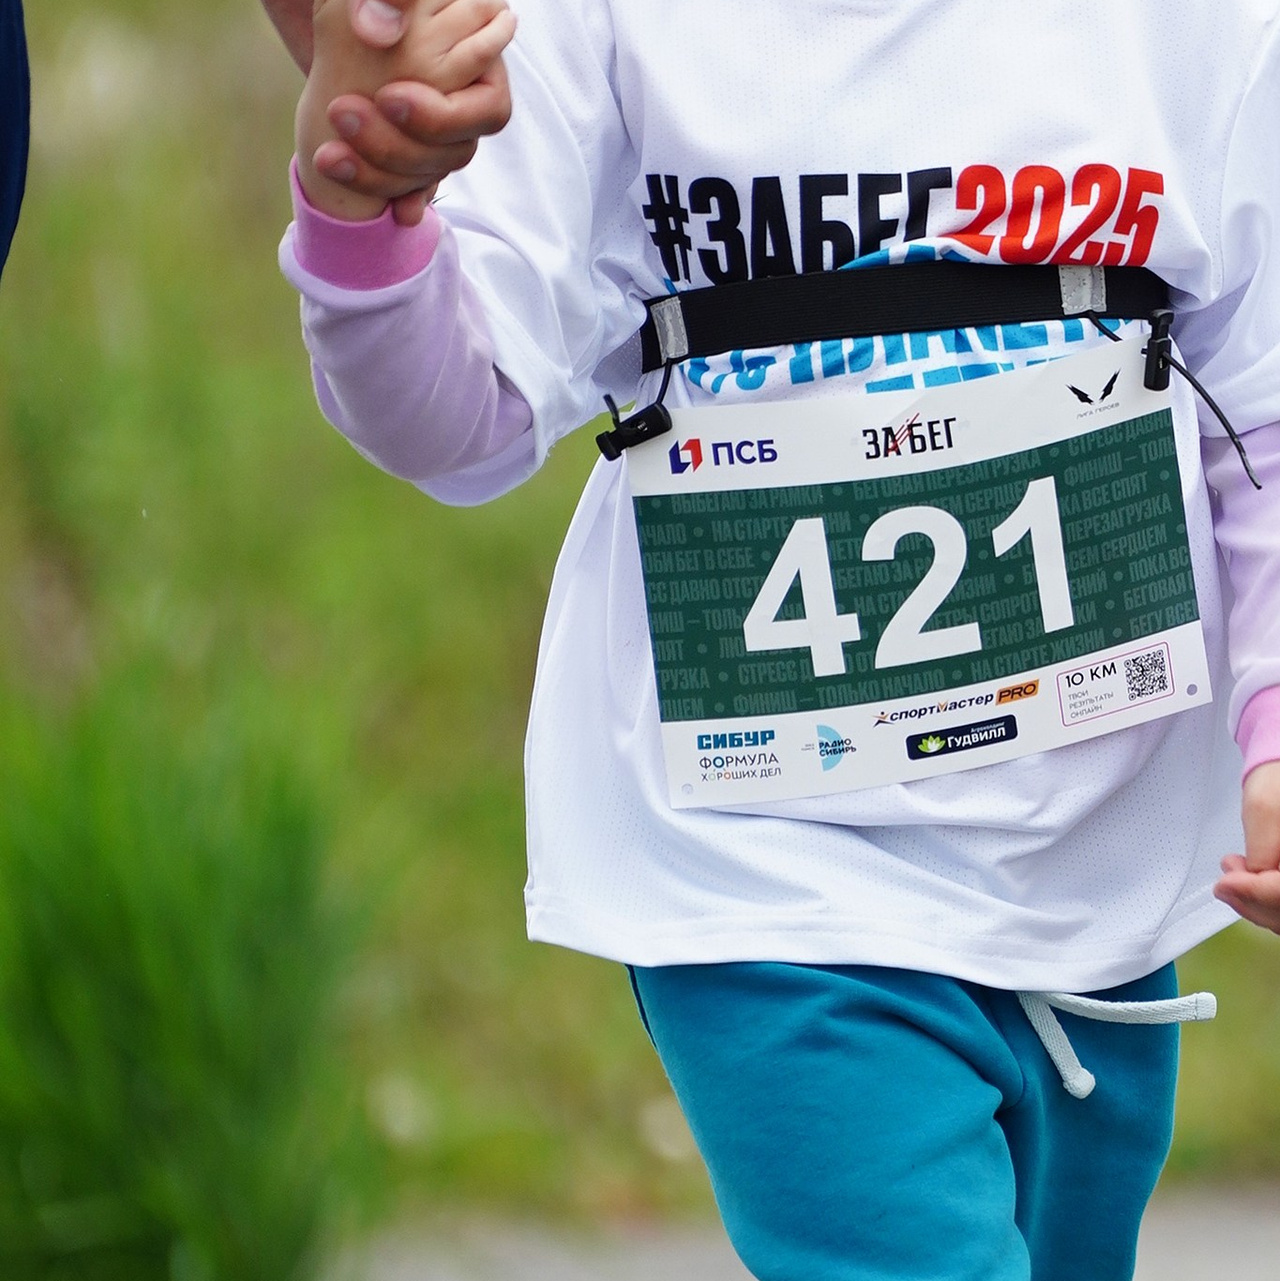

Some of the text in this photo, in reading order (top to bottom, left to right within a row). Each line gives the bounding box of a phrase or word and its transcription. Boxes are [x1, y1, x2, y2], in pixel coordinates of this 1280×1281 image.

[711, 439, 778, 466] ПСБ
[671, 491, 747, 514] ВЫБЕГАЮ
[749, 490, 770, 509] ЗА
[769, 486, 824, 509] РАМКИ
[926, 450, 1042, 491] ПЕРЕЗАГРУЗКА
[711, 520, 733, 542] НА
[965, 479, 1028, 514] СЕРДЦЕ
[1063, 451, 1123, 487] ФИНИШ
[675, 549, 701, 572] БЕГ
[703, 549, 715, 570] В
[716, 547, 755, 569] СЕБЕ
[1082, 483, 1111, 511] ВСЕ
[1110, 471, 1148, 501] СПЯТ
[669, 578, 721, 605] ДАВНО
[722, 575, 766, 600] ОТСТ
[832, 565, 889, 590] БЕГАЮ
[891, 560, 914, 582] ЗА
[1065, 493, 1172, 544] ПЕРЕЗАГРУЗКА
[702, 607, 750, 631] ТОЛЬ
[945, 573, 997, 604] ИЗНИ
[1066, 545, 1100, 572] СЕМ
[1101, 523, 1168, 562] СЕРДЦЕМ
[742, 476, 1076, 678] 421
[1128, 552, 1168, 582] ПОКА
[738, 660, 798, 685] СТРЕСС
[1123, 574, 1188, 611] БЕГОВАЯ
[733, 690, 797, 715] ФИНИШ
[816, 680, 880, 708] ТОЛЬКО
[881, 668, 945, 698] НАЧАЛО
[970, 659, 993, 682] НА
[993, 644, 1050, 675] СТАРТЕ
[1050, 628, 1105, 661] ЖИЗНИ
[1129, 609, 1163, 638] БЕГУ
[998, 683, 1036, 703] PRO
[1066, 672, 1084, 688] 10
[697, 730, 775, 750] СИБУР
[819, 738, 852, 750] РАДИО
[819, 746, 857, 757] СИБИРЬ
[699, 752, 779, 770] ФОРМУЛА
[701, 767, 781, 782] ХОРОШИХ ДЕЛ
